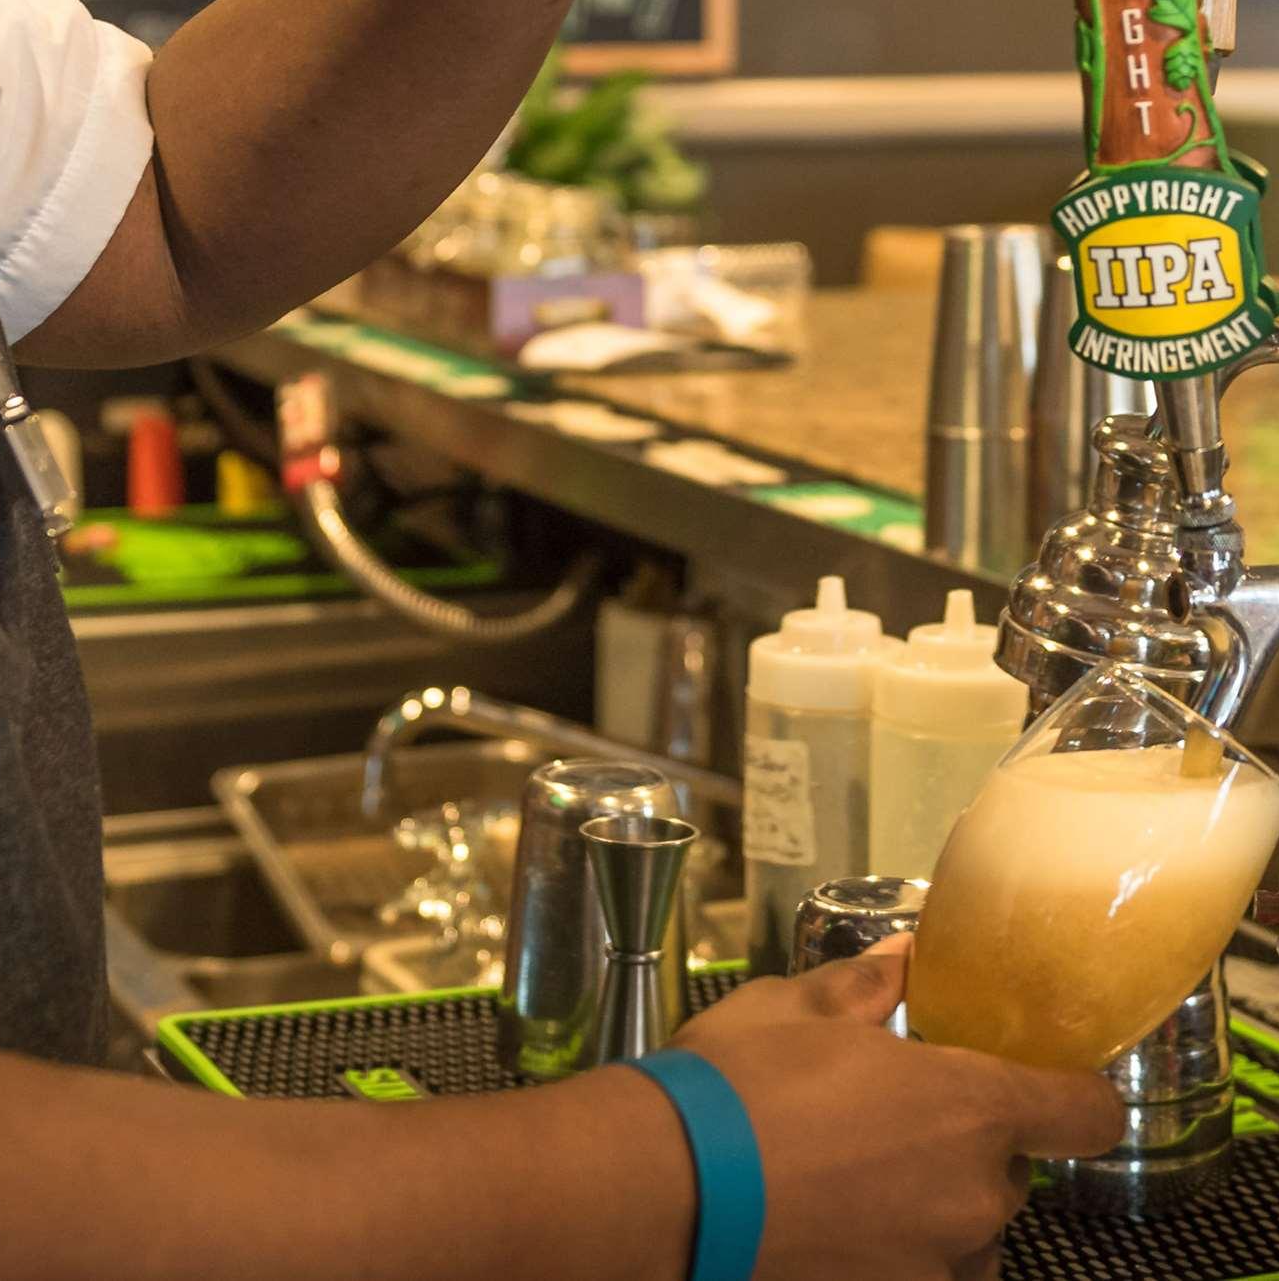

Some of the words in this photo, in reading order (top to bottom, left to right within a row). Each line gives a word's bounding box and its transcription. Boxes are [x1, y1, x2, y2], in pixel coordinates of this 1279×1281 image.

[1056, 179, 1244, 238] HOPPYRIGHT
[1087, 237, 1236, 310] IIPA
[1074, 310, 1263, 374] INFRINGEMENT
